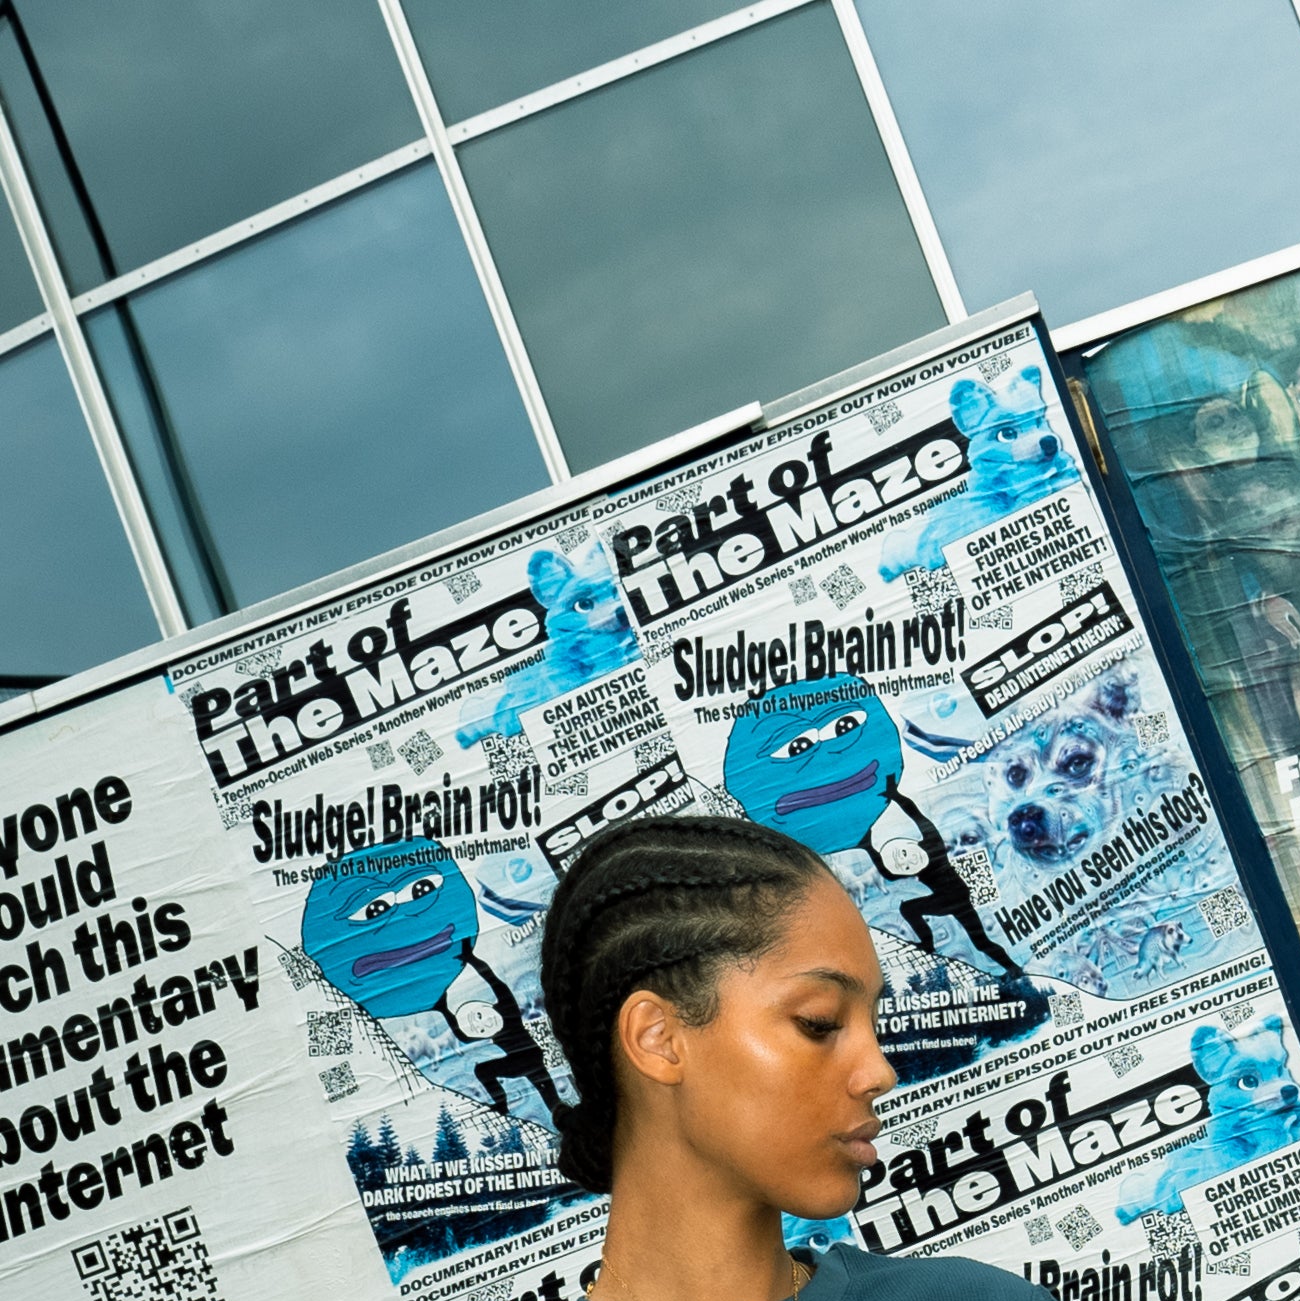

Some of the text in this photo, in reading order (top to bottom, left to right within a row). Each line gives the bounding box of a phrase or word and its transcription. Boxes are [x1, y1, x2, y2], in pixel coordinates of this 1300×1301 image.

[592, 326, 1029, 519] DOCUMENTARY! NEW EPISODE OUT NOW ON YOUTUBE!
[614, 431, 837, 570] Part of
[621, 437, 963, 616] The Maze
[966, 497, 1070, 556] GAY AUTISTIC
[975, 514, 1075, 571] FURRIES ARE
[642, 479, 968, 642] Techno-Occult Web Series "Another World" has spawned!
[971, 525, 1091, 590] THE ILLUMINATI
[971, 536, 1107, 610] OF THE INTERNET!
[191, 599, 412, 735] Part of
[673, 598, 966, 703] Sludge! Brain rot!
[970, 591, 1112, 691] SLOP!
[984, 614, 1124, 708] DEAD INTERNET THEORY:
[203, 609, 540, 779] The Maze
[694, 669, 955, 724] The story of a hyperstition nightmare!
[927, 632, 1144, 784] Your Feed is Already 90% Necro-AI!
[253, 764, 541, 863] Sludge! Brain rot!
[994, 772, 1212, 946] Have you seen this dog?
[72, 896, 191, 983] this
[124, 1040, 228, 1113] the
[384, 1148, 546, 1183] WHAT IF WE KISSED IN
[857, 1084, 1202, 1252] The Maze
[860, 1071, 1072, 1200] Part of
[359, 1173, 515, 1210] DARK FOREST OF THE
